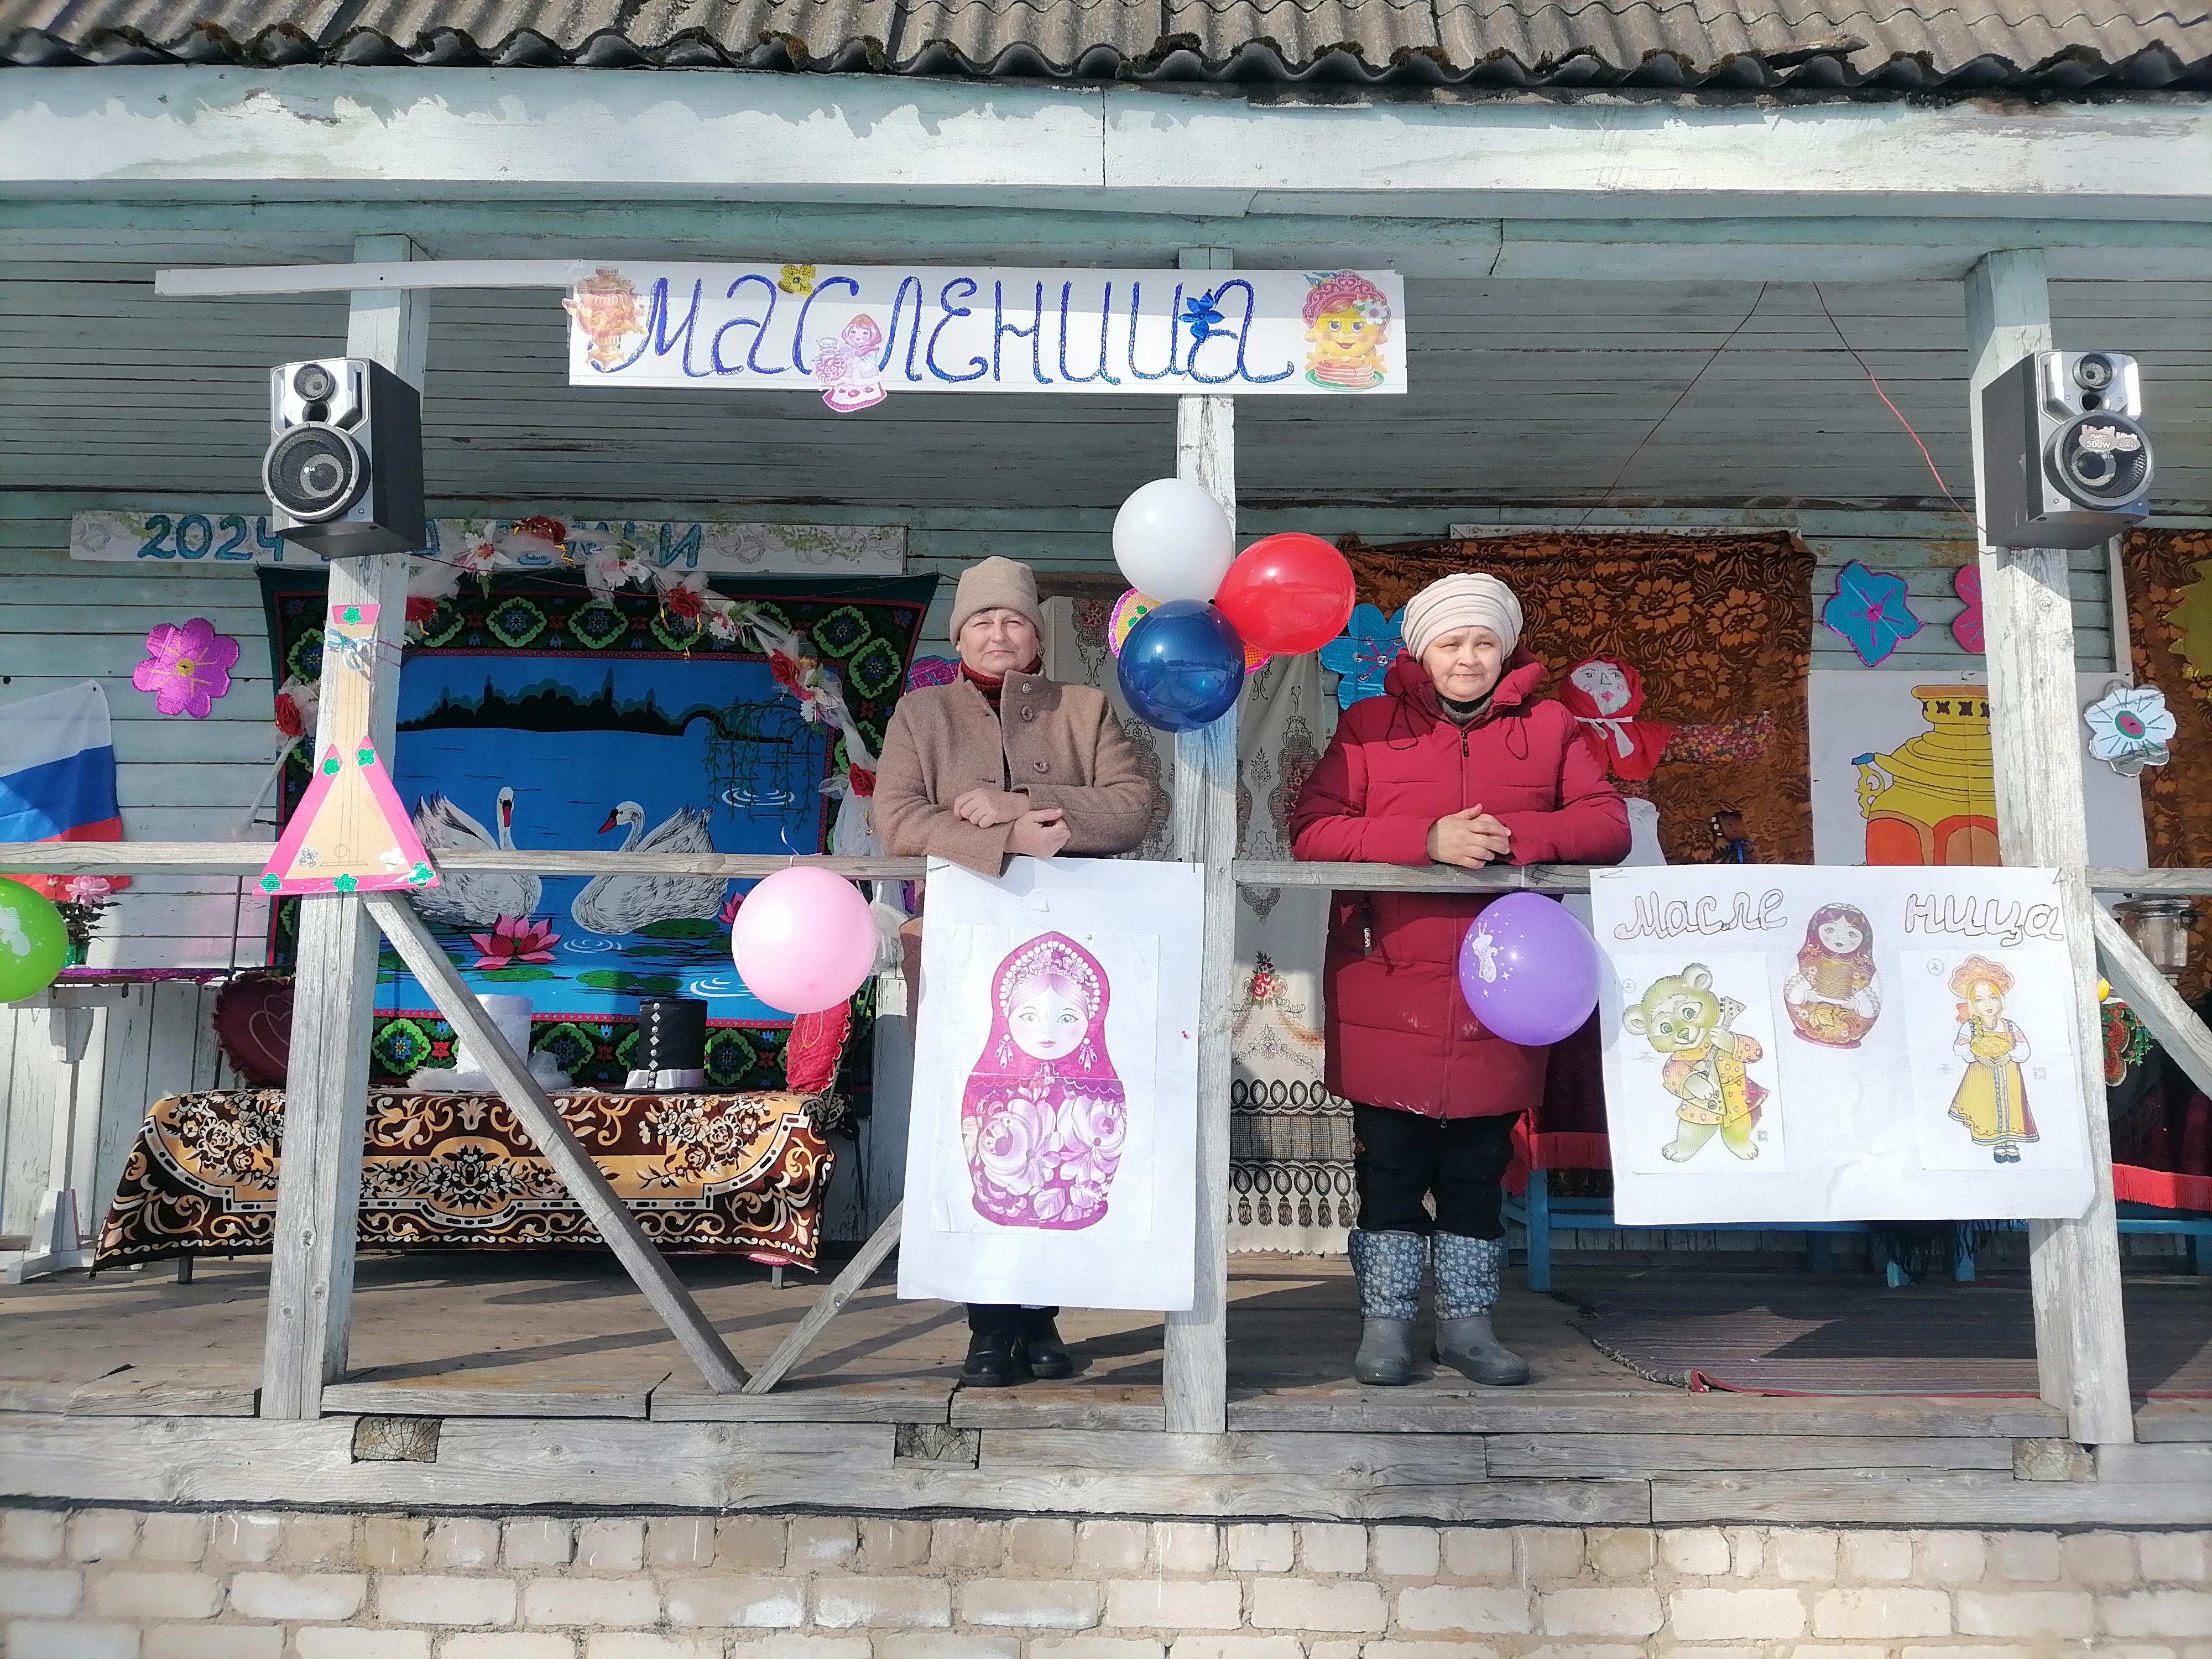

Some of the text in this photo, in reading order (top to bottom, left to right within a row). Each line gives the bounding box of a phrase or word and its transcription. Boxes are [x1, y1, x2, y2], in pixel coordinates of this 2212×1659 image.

[2086, 440, 2111, 448] 500W
[137, 514, 285, 561] 2024
[1614, 889, 1788, 940] Масле
